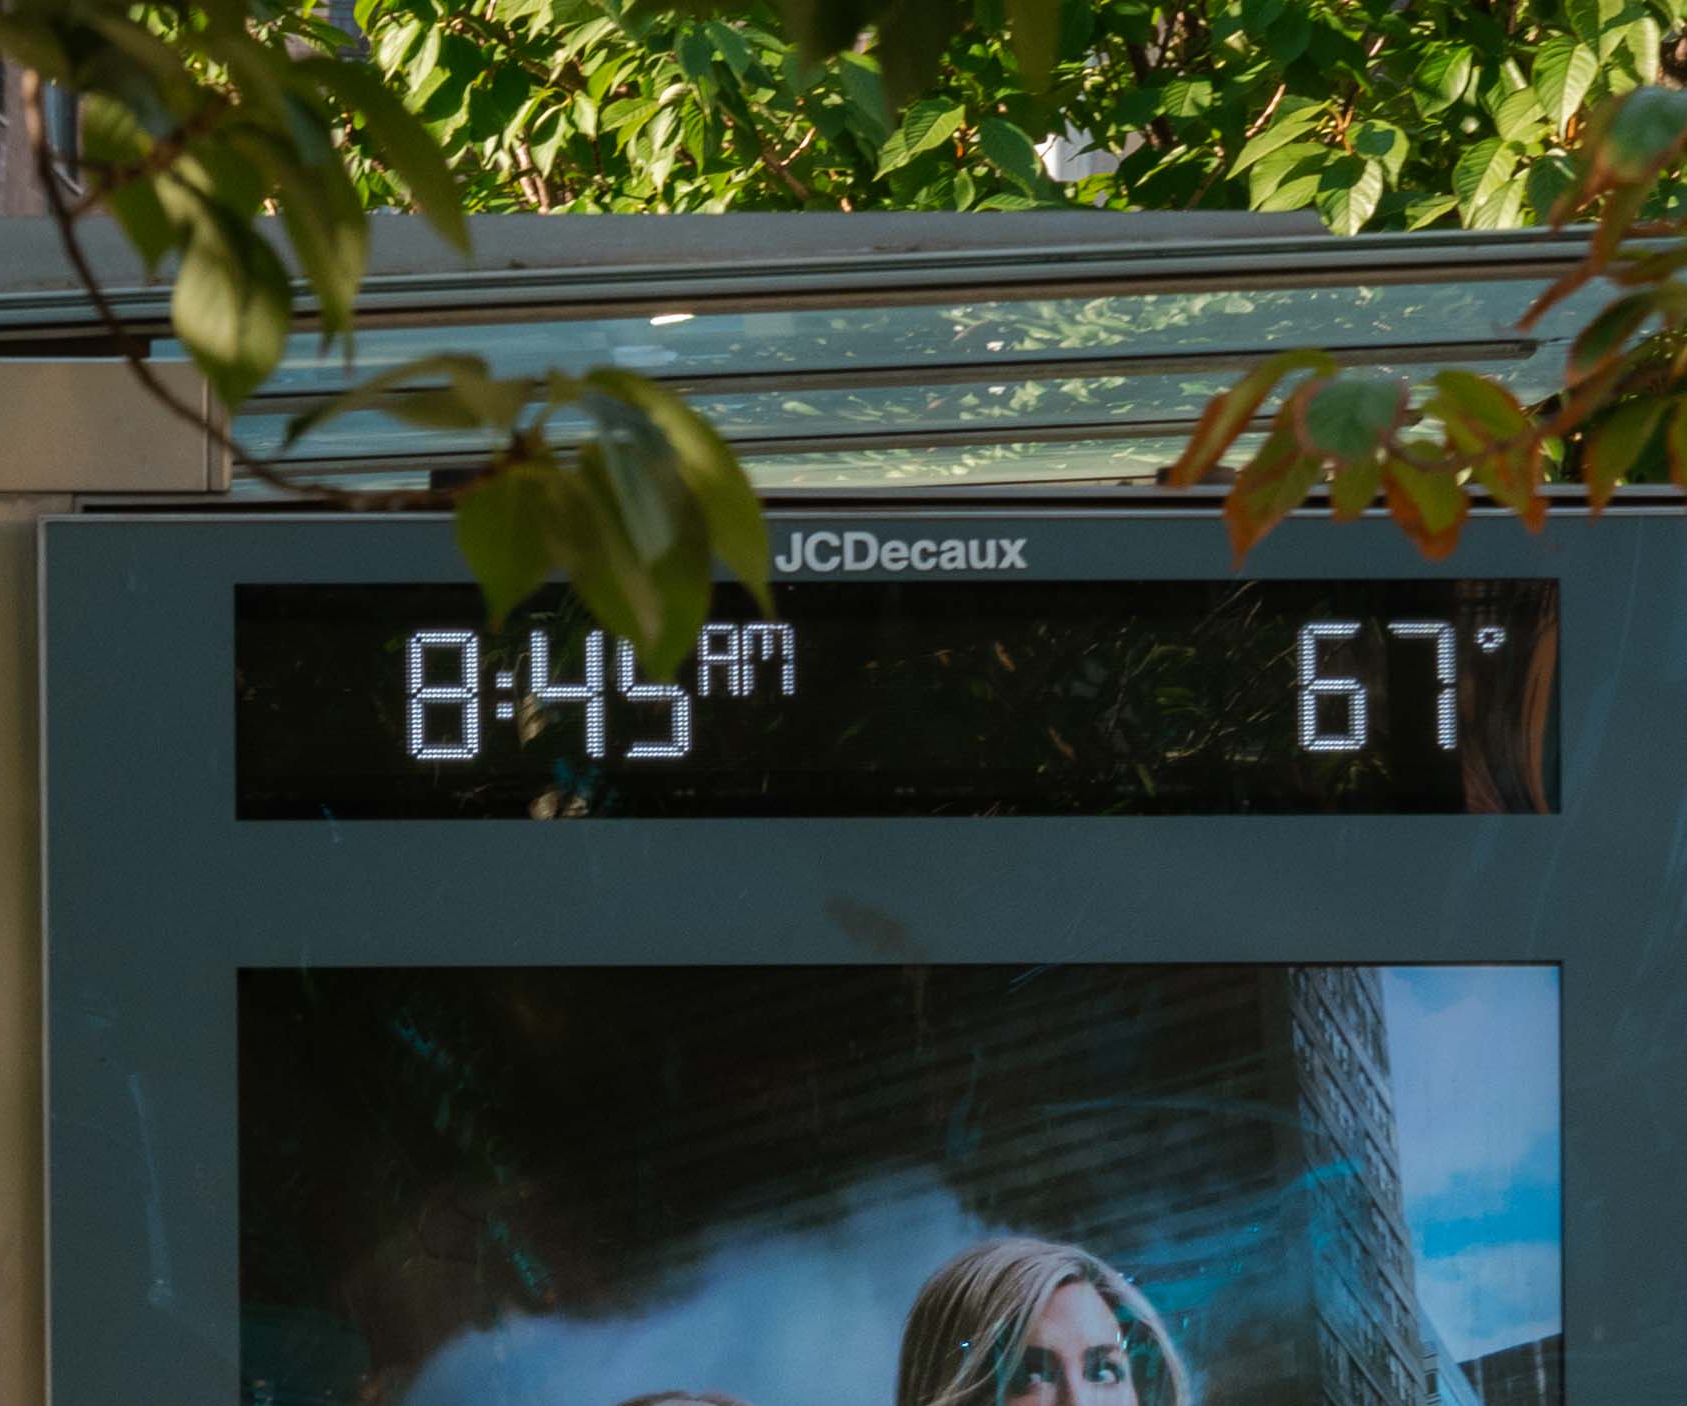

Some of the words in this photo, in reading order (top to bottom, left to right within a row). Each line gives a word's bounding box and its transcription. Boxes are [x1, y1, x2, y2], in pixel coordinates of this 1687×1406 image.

[774, 531, 1028, 572] JCDecaux
[407, 628, 691, 760] 8:45
[697, 623, 796, 697] AM
